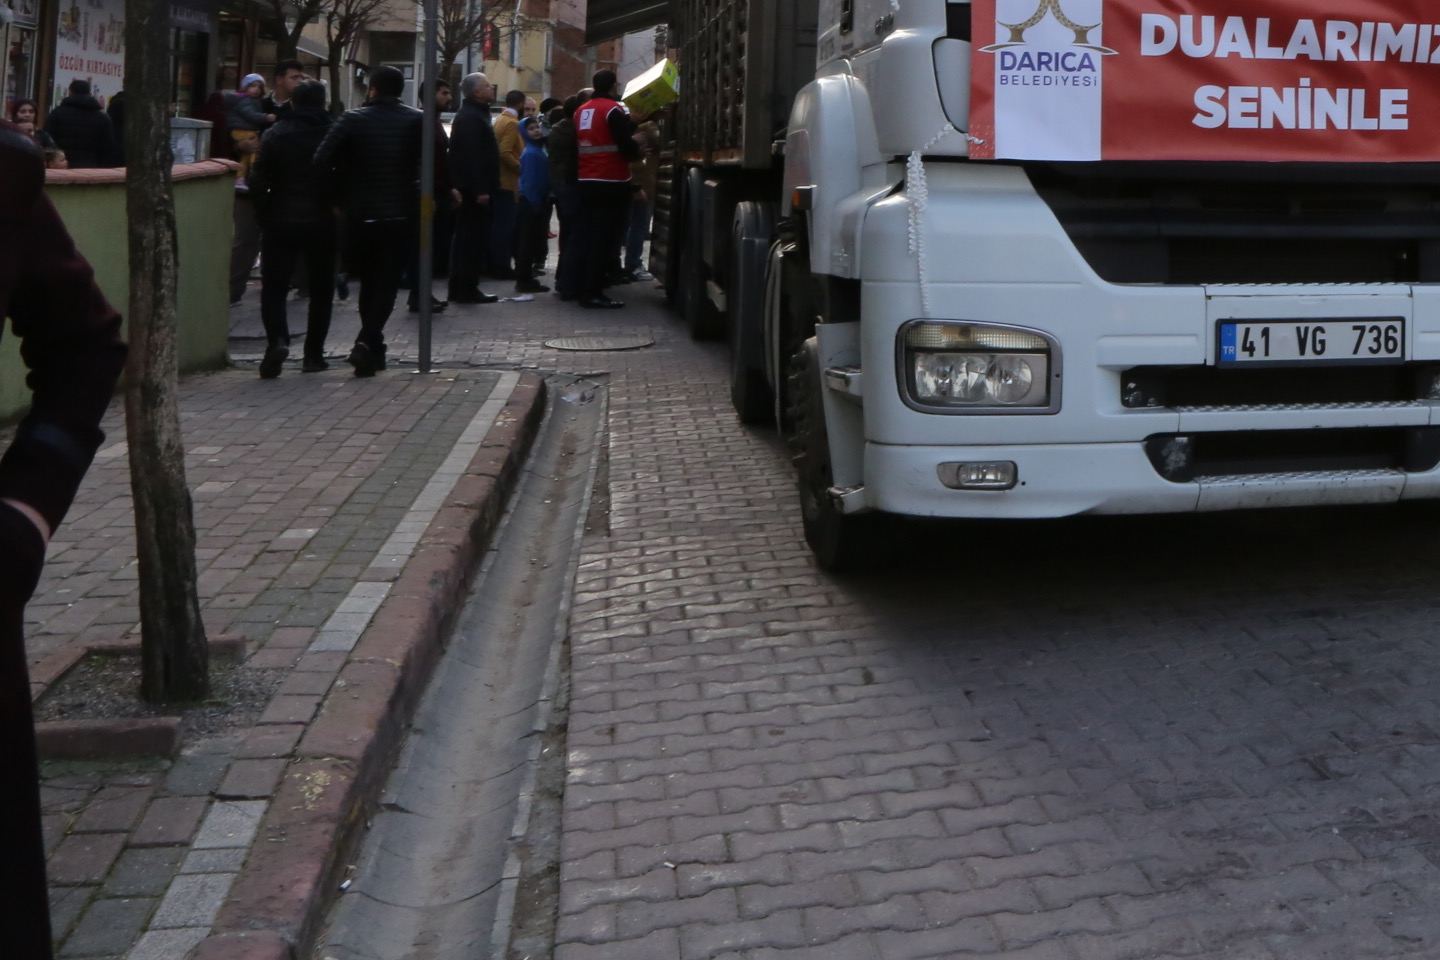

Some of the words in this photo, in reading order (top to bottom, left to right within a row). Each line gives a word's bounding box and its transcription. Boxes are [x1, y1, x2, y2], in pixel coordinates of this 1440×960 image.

[1000, 51, 1096, 72] DARICA
[1192, 77, 1408, 130] SENİNLE
[1223, 346, 1235, 355] TR
[1241, 326, 1270, 357] 41
[1296, 326, 1326, 356] VG
[1352, 324, 1398, 355] 736
